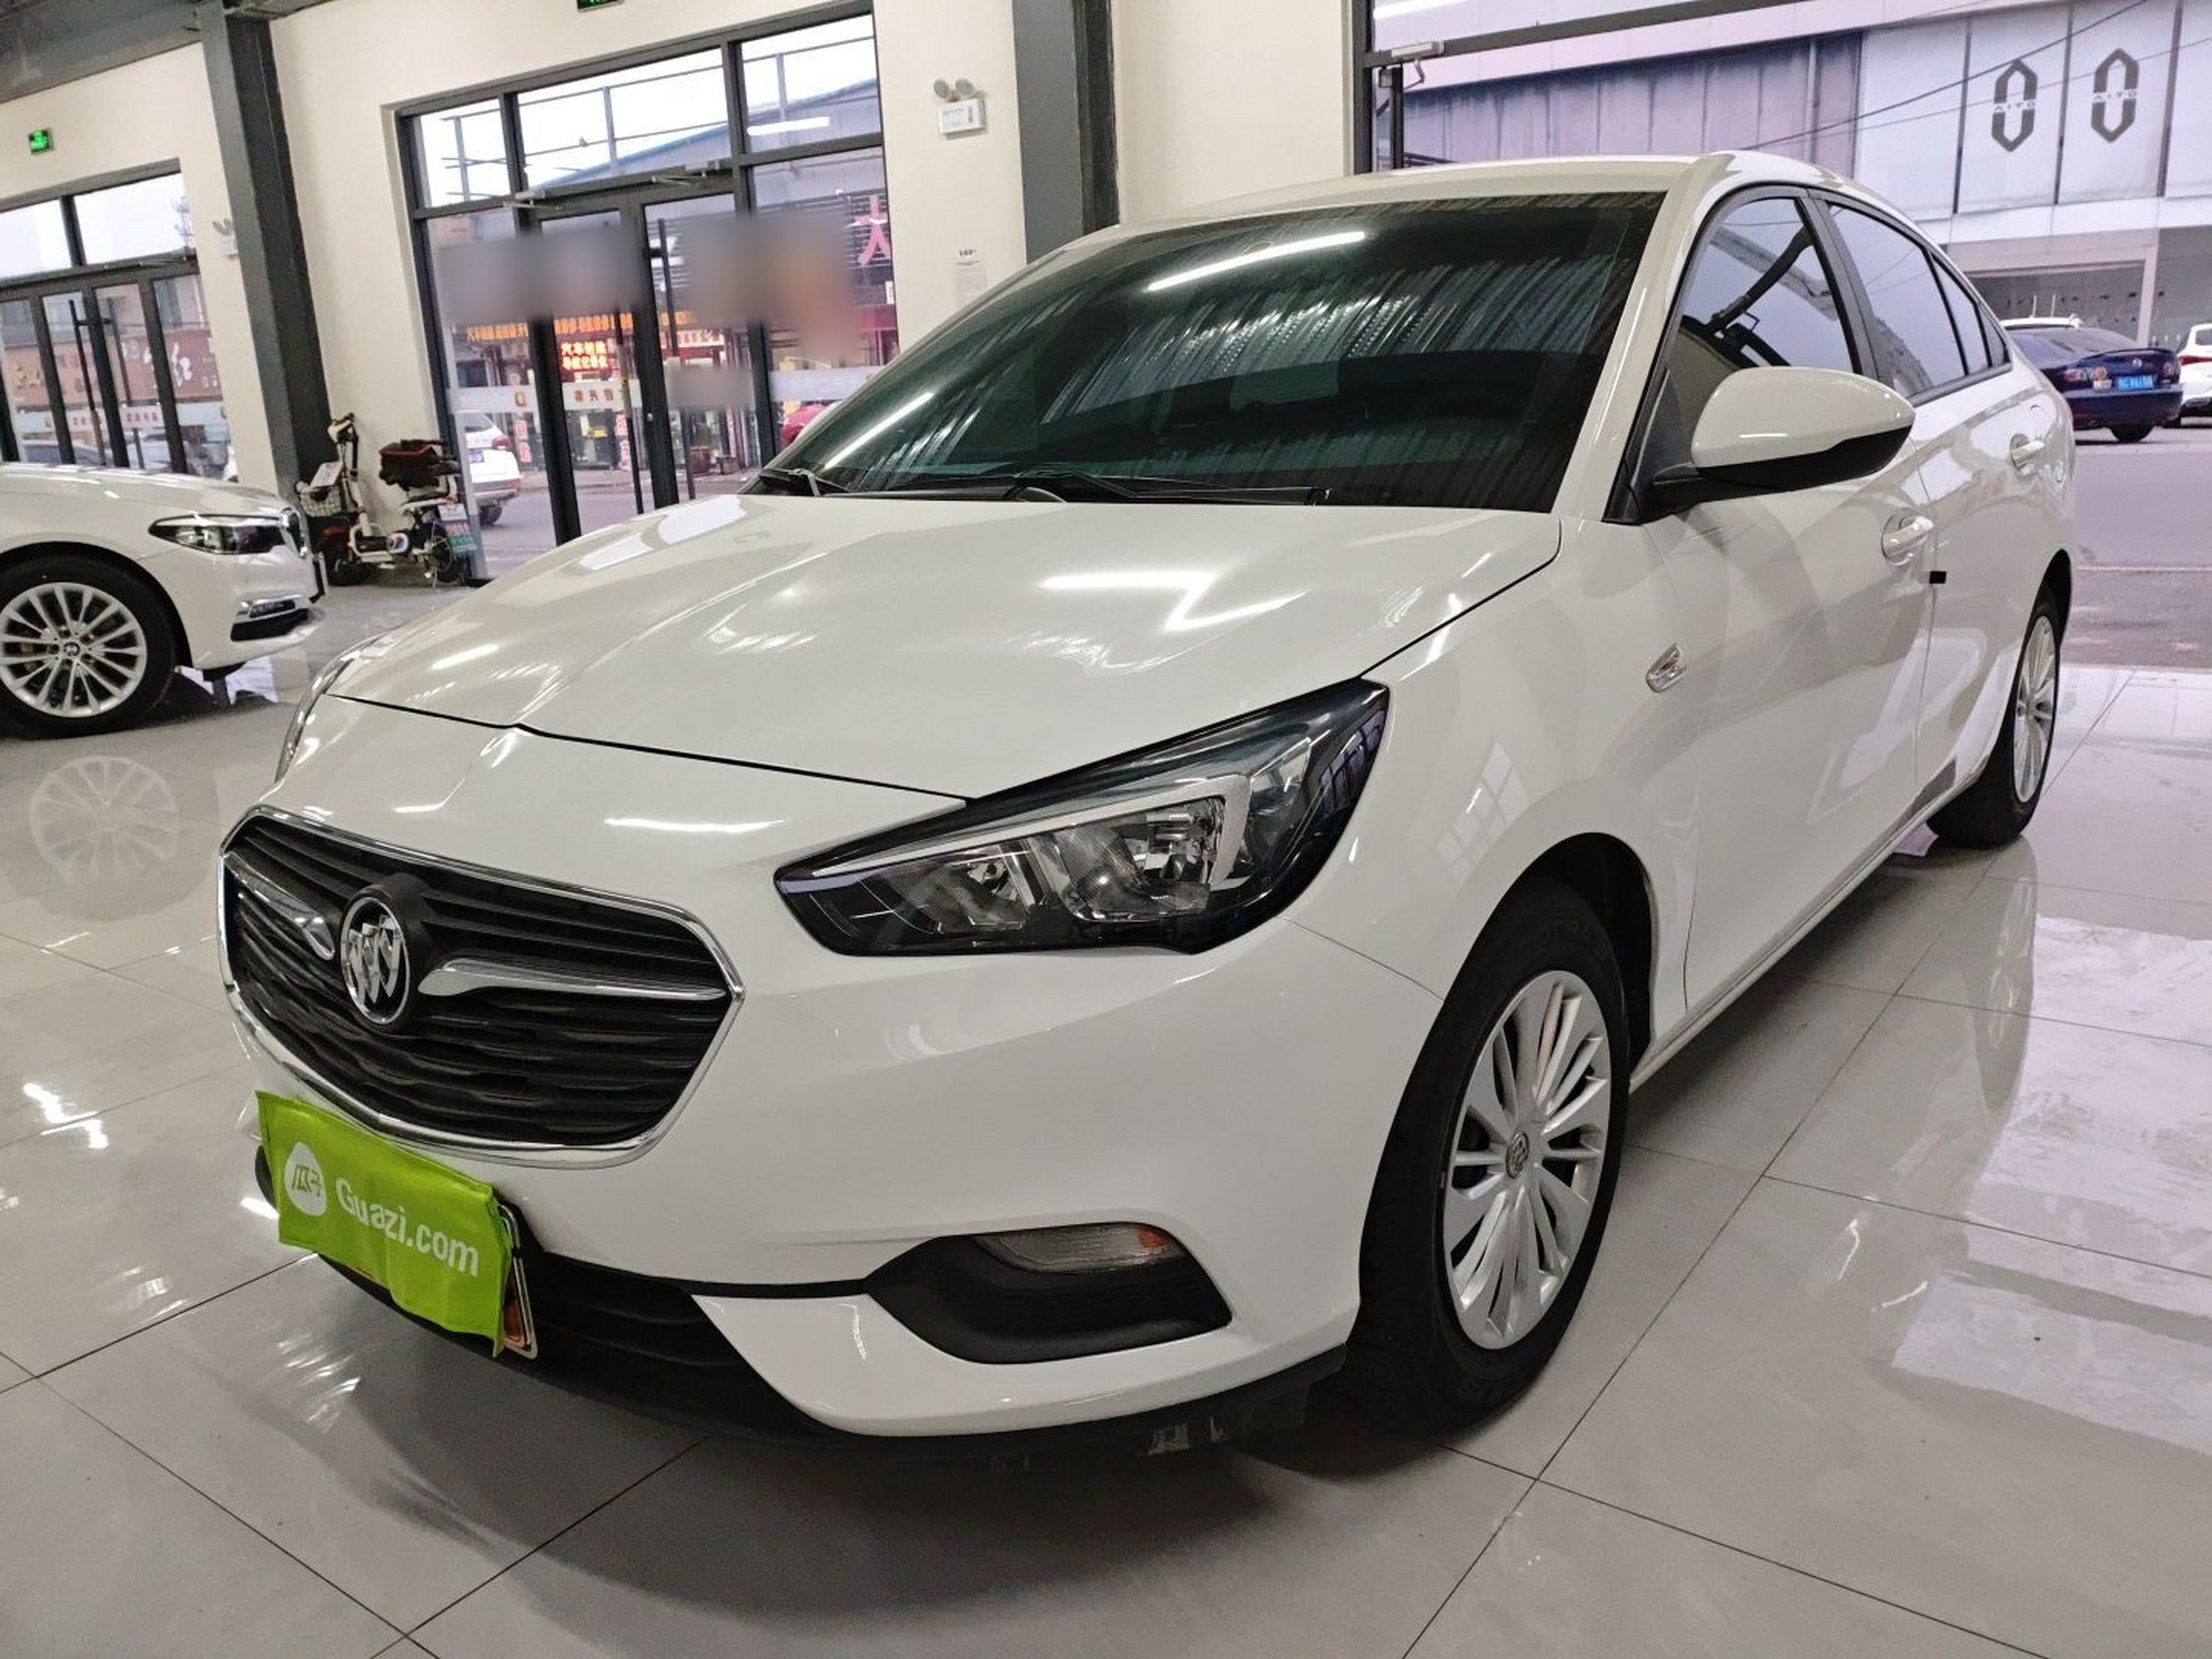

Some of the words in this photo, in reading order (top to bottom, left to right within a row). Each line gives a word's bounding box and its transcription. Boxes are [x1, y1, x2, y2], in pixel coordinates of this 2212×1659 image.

[2094, 90, 2137, 101] AITO
[1994, 101, 2036, 111] AITO
[336, 1178, 479, 1277] Guazi.com
